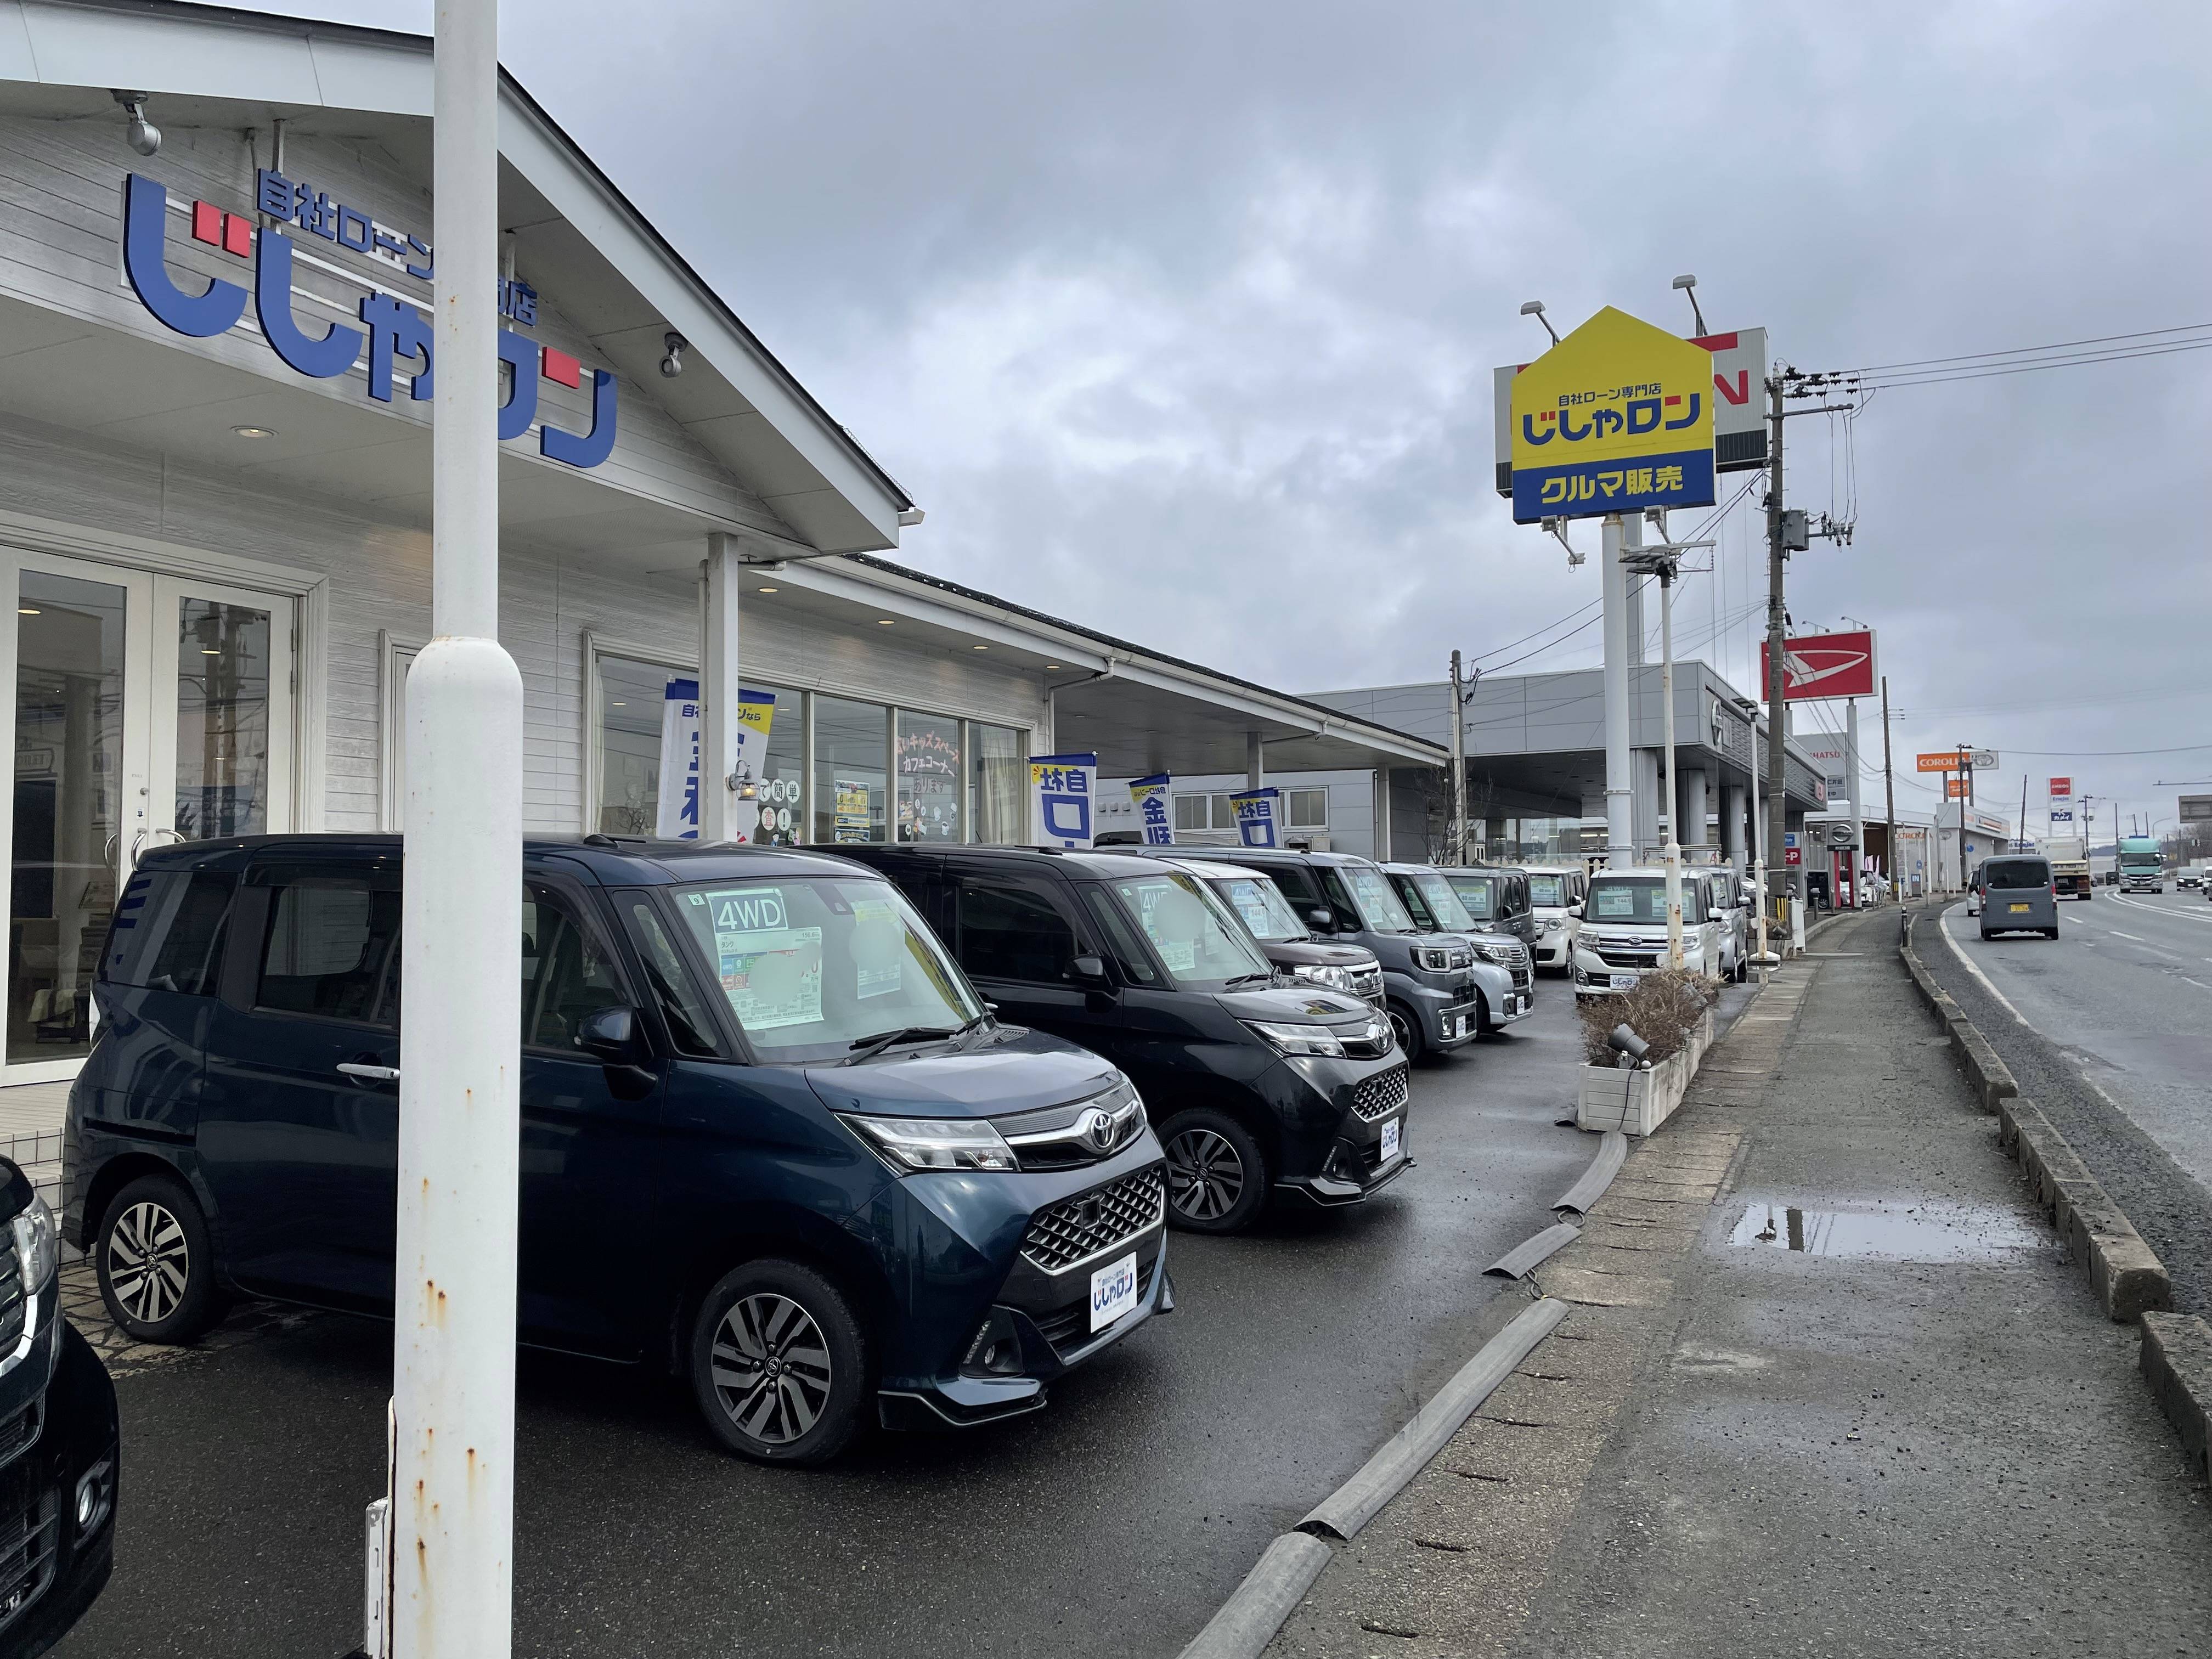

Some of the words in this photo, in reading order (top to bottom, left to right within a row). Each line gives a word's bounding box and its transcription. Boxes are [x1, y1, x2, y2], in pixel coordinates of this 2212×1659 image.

[257, 168, 538, 327] 自社ローン店
[1559, 382, 1662, 407] 自社ローン専門店
[1523, 393, 1700, 445] じしゃロン
[1541, 465, 1683, 504] クルマ販売
[904, 755, 955, 777] カフェコーナー
[1810, 751, 1840, 759] HATSU
[718, 899, 781, 929] 4WD
